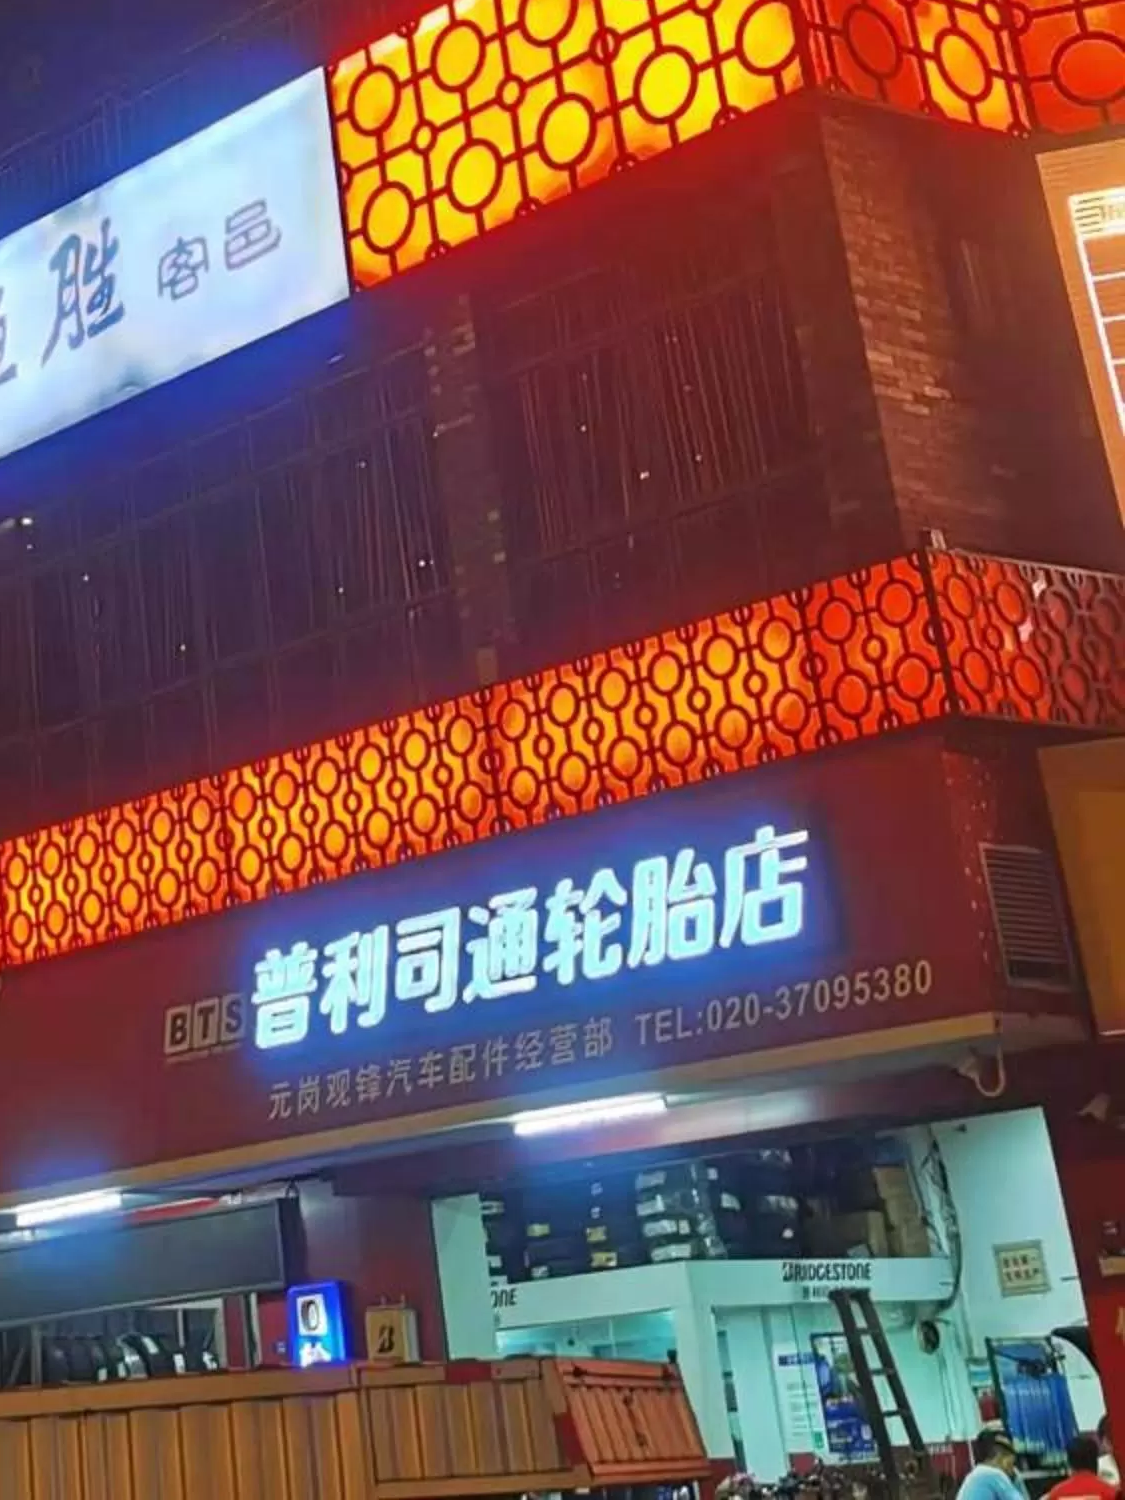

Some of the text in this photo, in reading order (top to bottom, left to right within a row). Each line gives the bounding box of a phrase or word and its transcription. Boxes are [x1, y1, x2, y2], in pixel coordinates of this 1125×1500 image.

[251, 824, 809, 1051] 普利司通轮胎店
[169, 998, 243, 1046] BTS
[635, 959, 933, 1045] TEL:020-37095380
[782, 1262, 872, 1282] BRIDGESTONE
